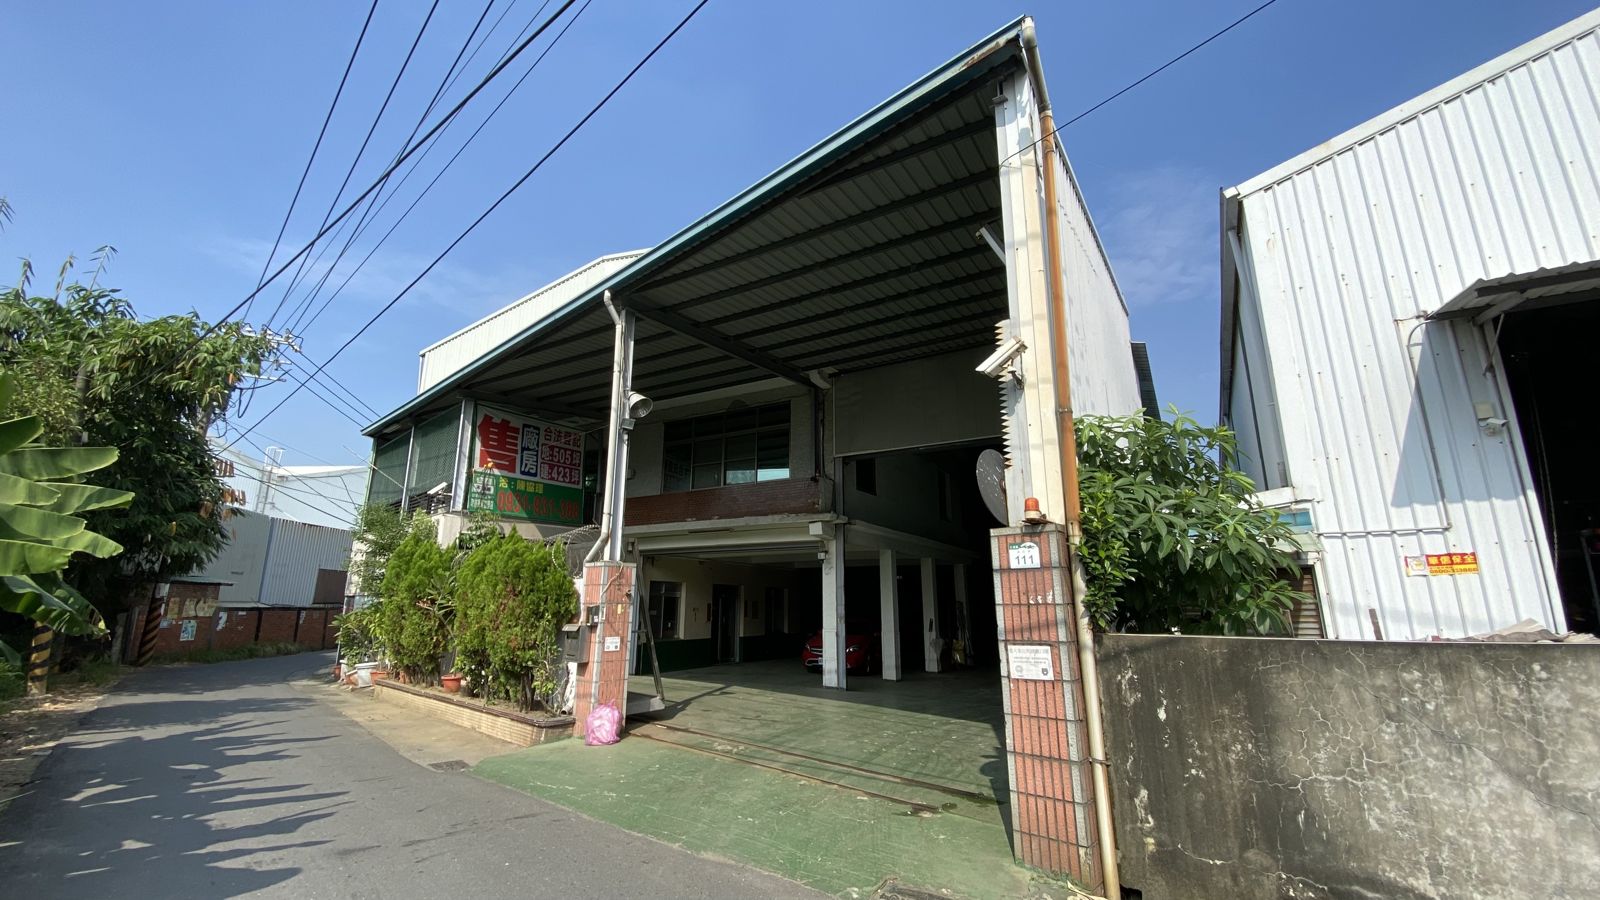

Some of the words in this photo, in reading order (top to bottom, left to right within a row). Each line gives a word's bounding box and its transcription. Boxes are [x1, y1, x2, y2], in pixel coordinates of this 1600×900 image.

[478, 414, 520, 473] 售
[521, 427, 538, 473] 廠房
[1015, 554, 1034, 566] 111
